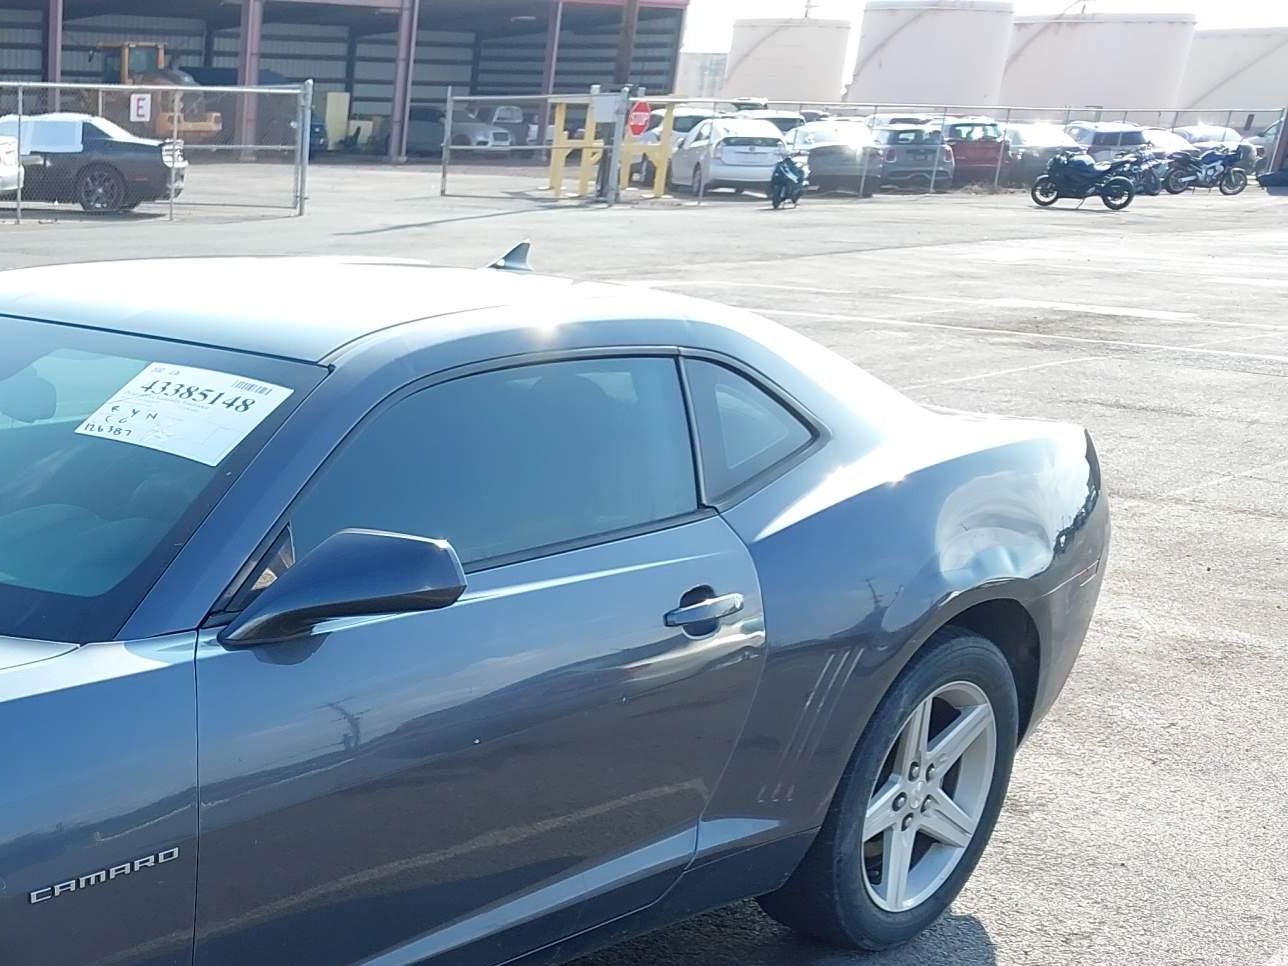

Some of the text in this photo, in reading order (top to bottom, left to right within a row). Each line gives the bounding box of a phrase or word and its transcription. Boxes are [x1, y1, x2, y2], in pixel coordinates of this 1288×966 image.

[136, 97, 146, 118] E
[140, 379, 256, 413] 43385148
[30, 847, 179, 904] CAMARO
